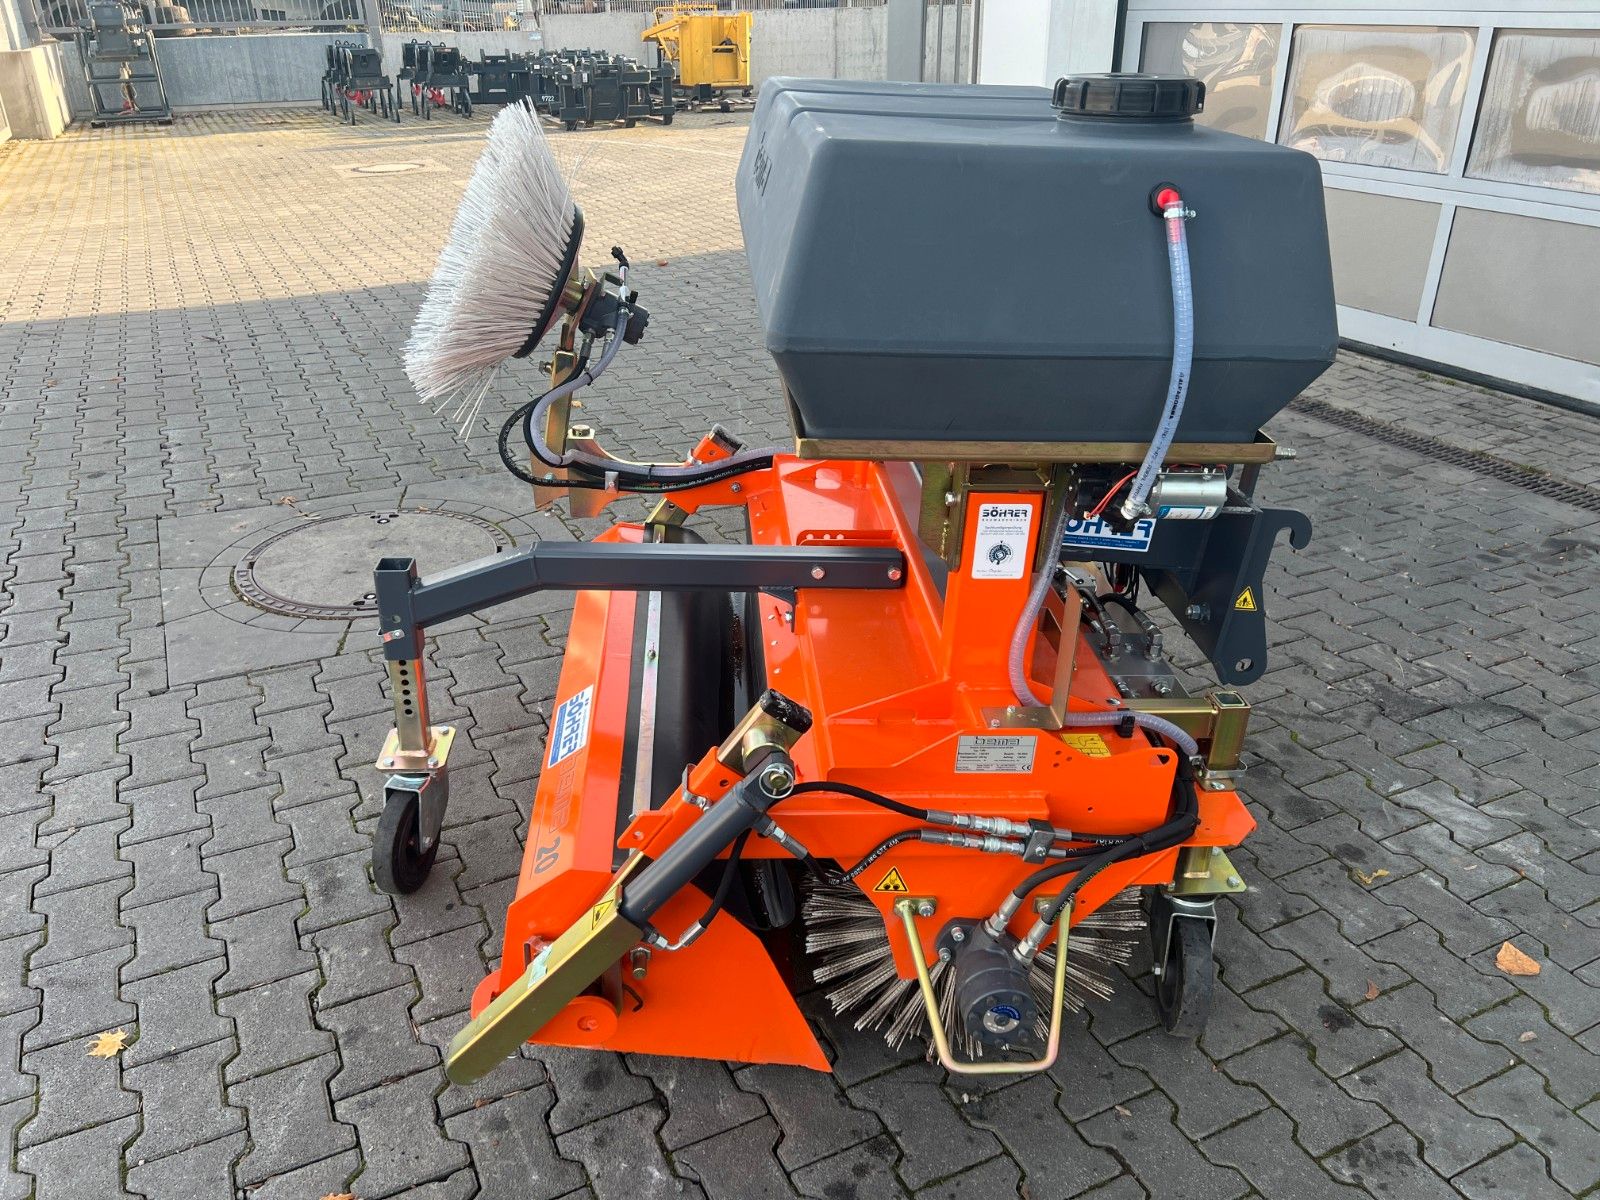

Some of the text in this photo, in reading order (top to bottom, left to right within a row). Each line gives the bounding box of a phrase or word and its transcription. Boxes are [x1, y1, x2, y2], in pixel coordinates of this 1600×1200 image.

[982, 507, 1028, 517] SÖHRER
[561, 691, 589, 759] SÖHRER
[534, 836, 561, 875] 20
